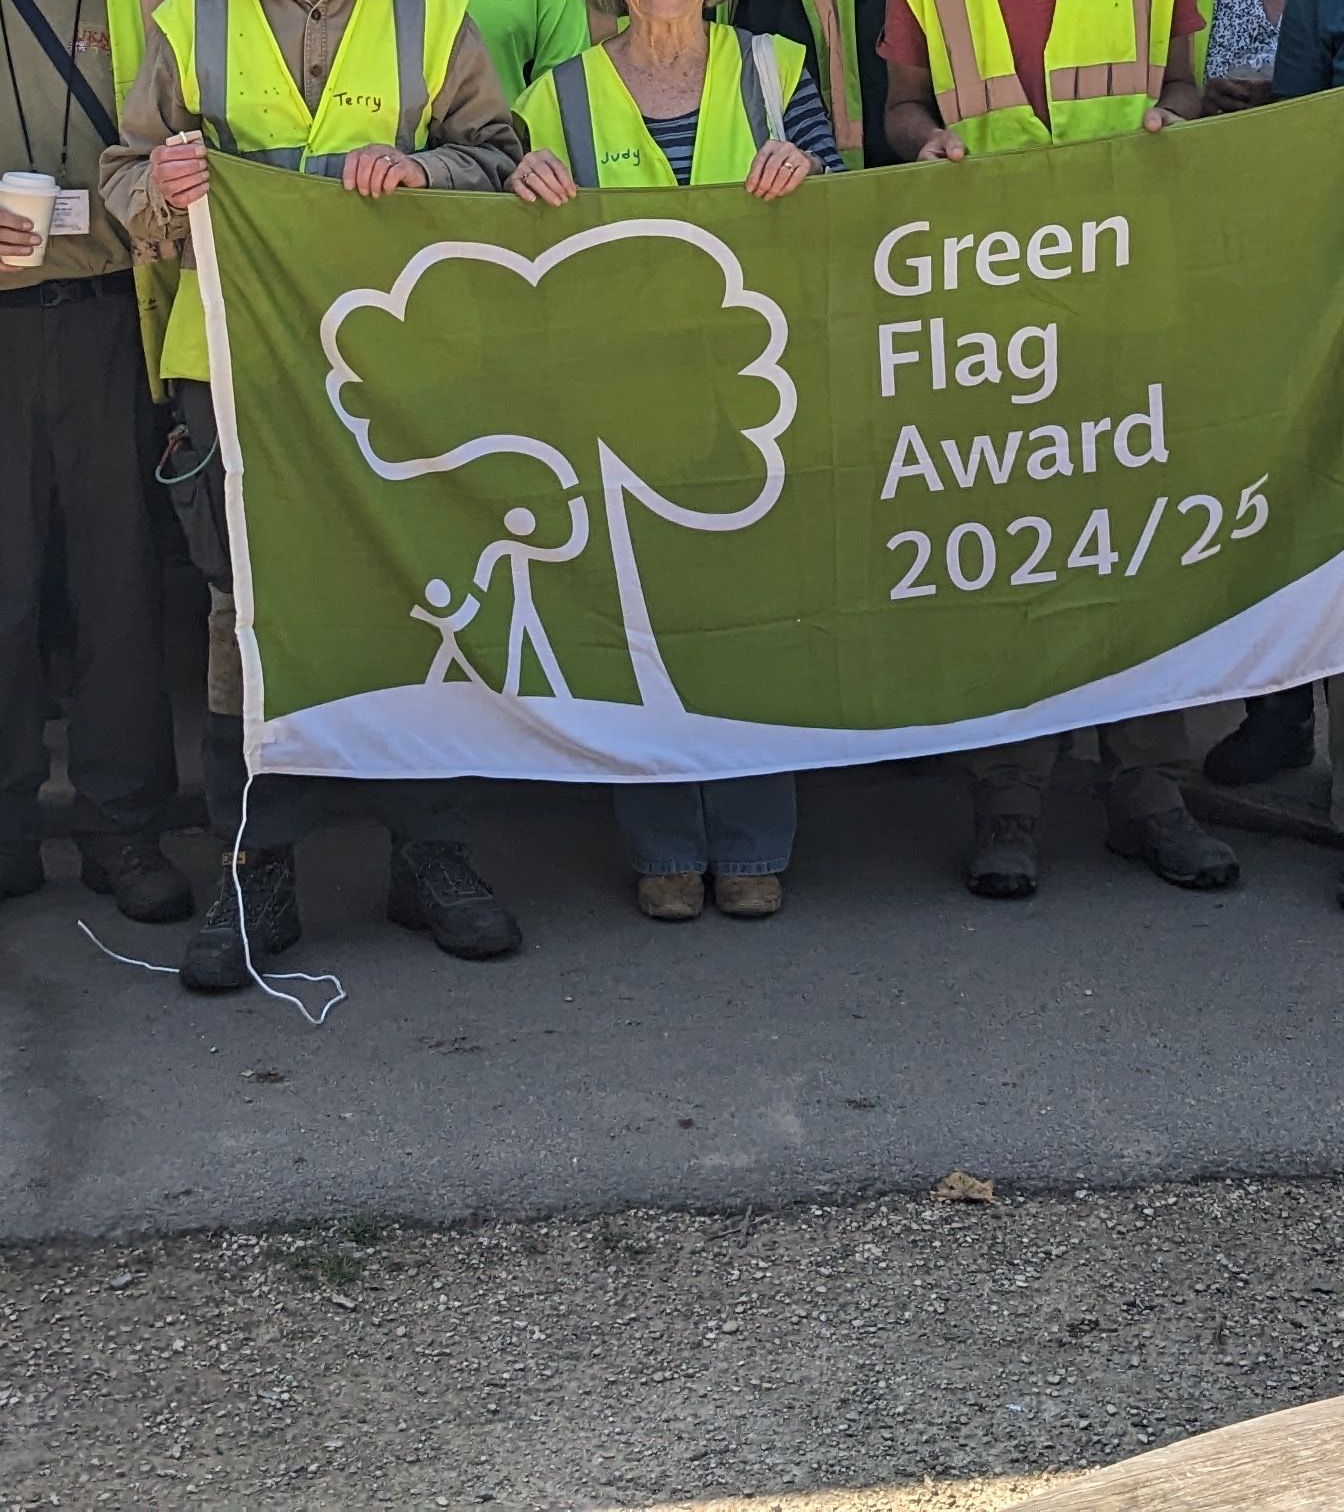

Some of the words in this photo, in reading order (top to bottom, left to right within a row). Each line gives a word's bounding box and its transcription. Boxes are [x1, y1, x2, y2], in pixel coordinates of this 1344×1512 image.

[333, 92, 381, 112] Terry
[601, 148, 640, 166] Judy
[874, 215, 1130, 296] Green
[878, 317, 1058, 404] Flag
[880, 383, 1169, 500] Award
[885, 473, 1269, 601] 2024/25
